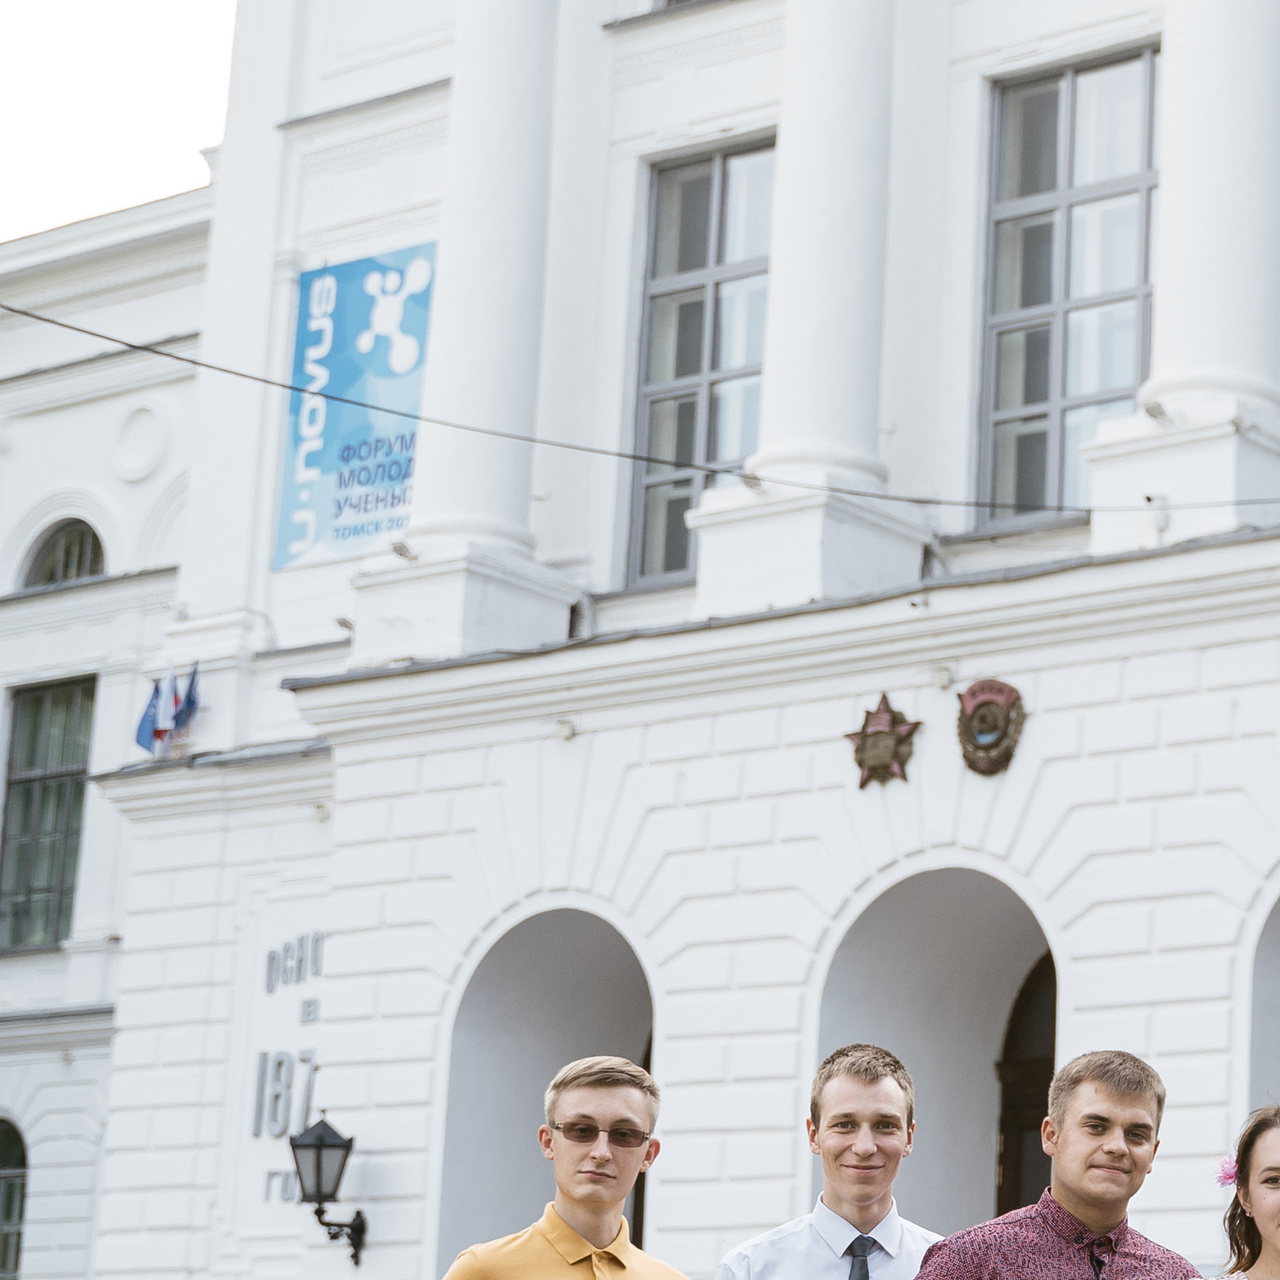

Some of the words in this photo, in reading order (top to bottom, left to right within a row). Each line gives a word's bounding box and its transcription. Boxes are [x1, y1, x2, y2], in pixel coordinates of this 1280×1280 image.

[340, 432, 416, 464] ФОРУМ
[338, 457, 413, 490] МОЛОД
[334, 485, 412, 519] УЧЕНЫ
[253, 1050, 315, 1137] 187
